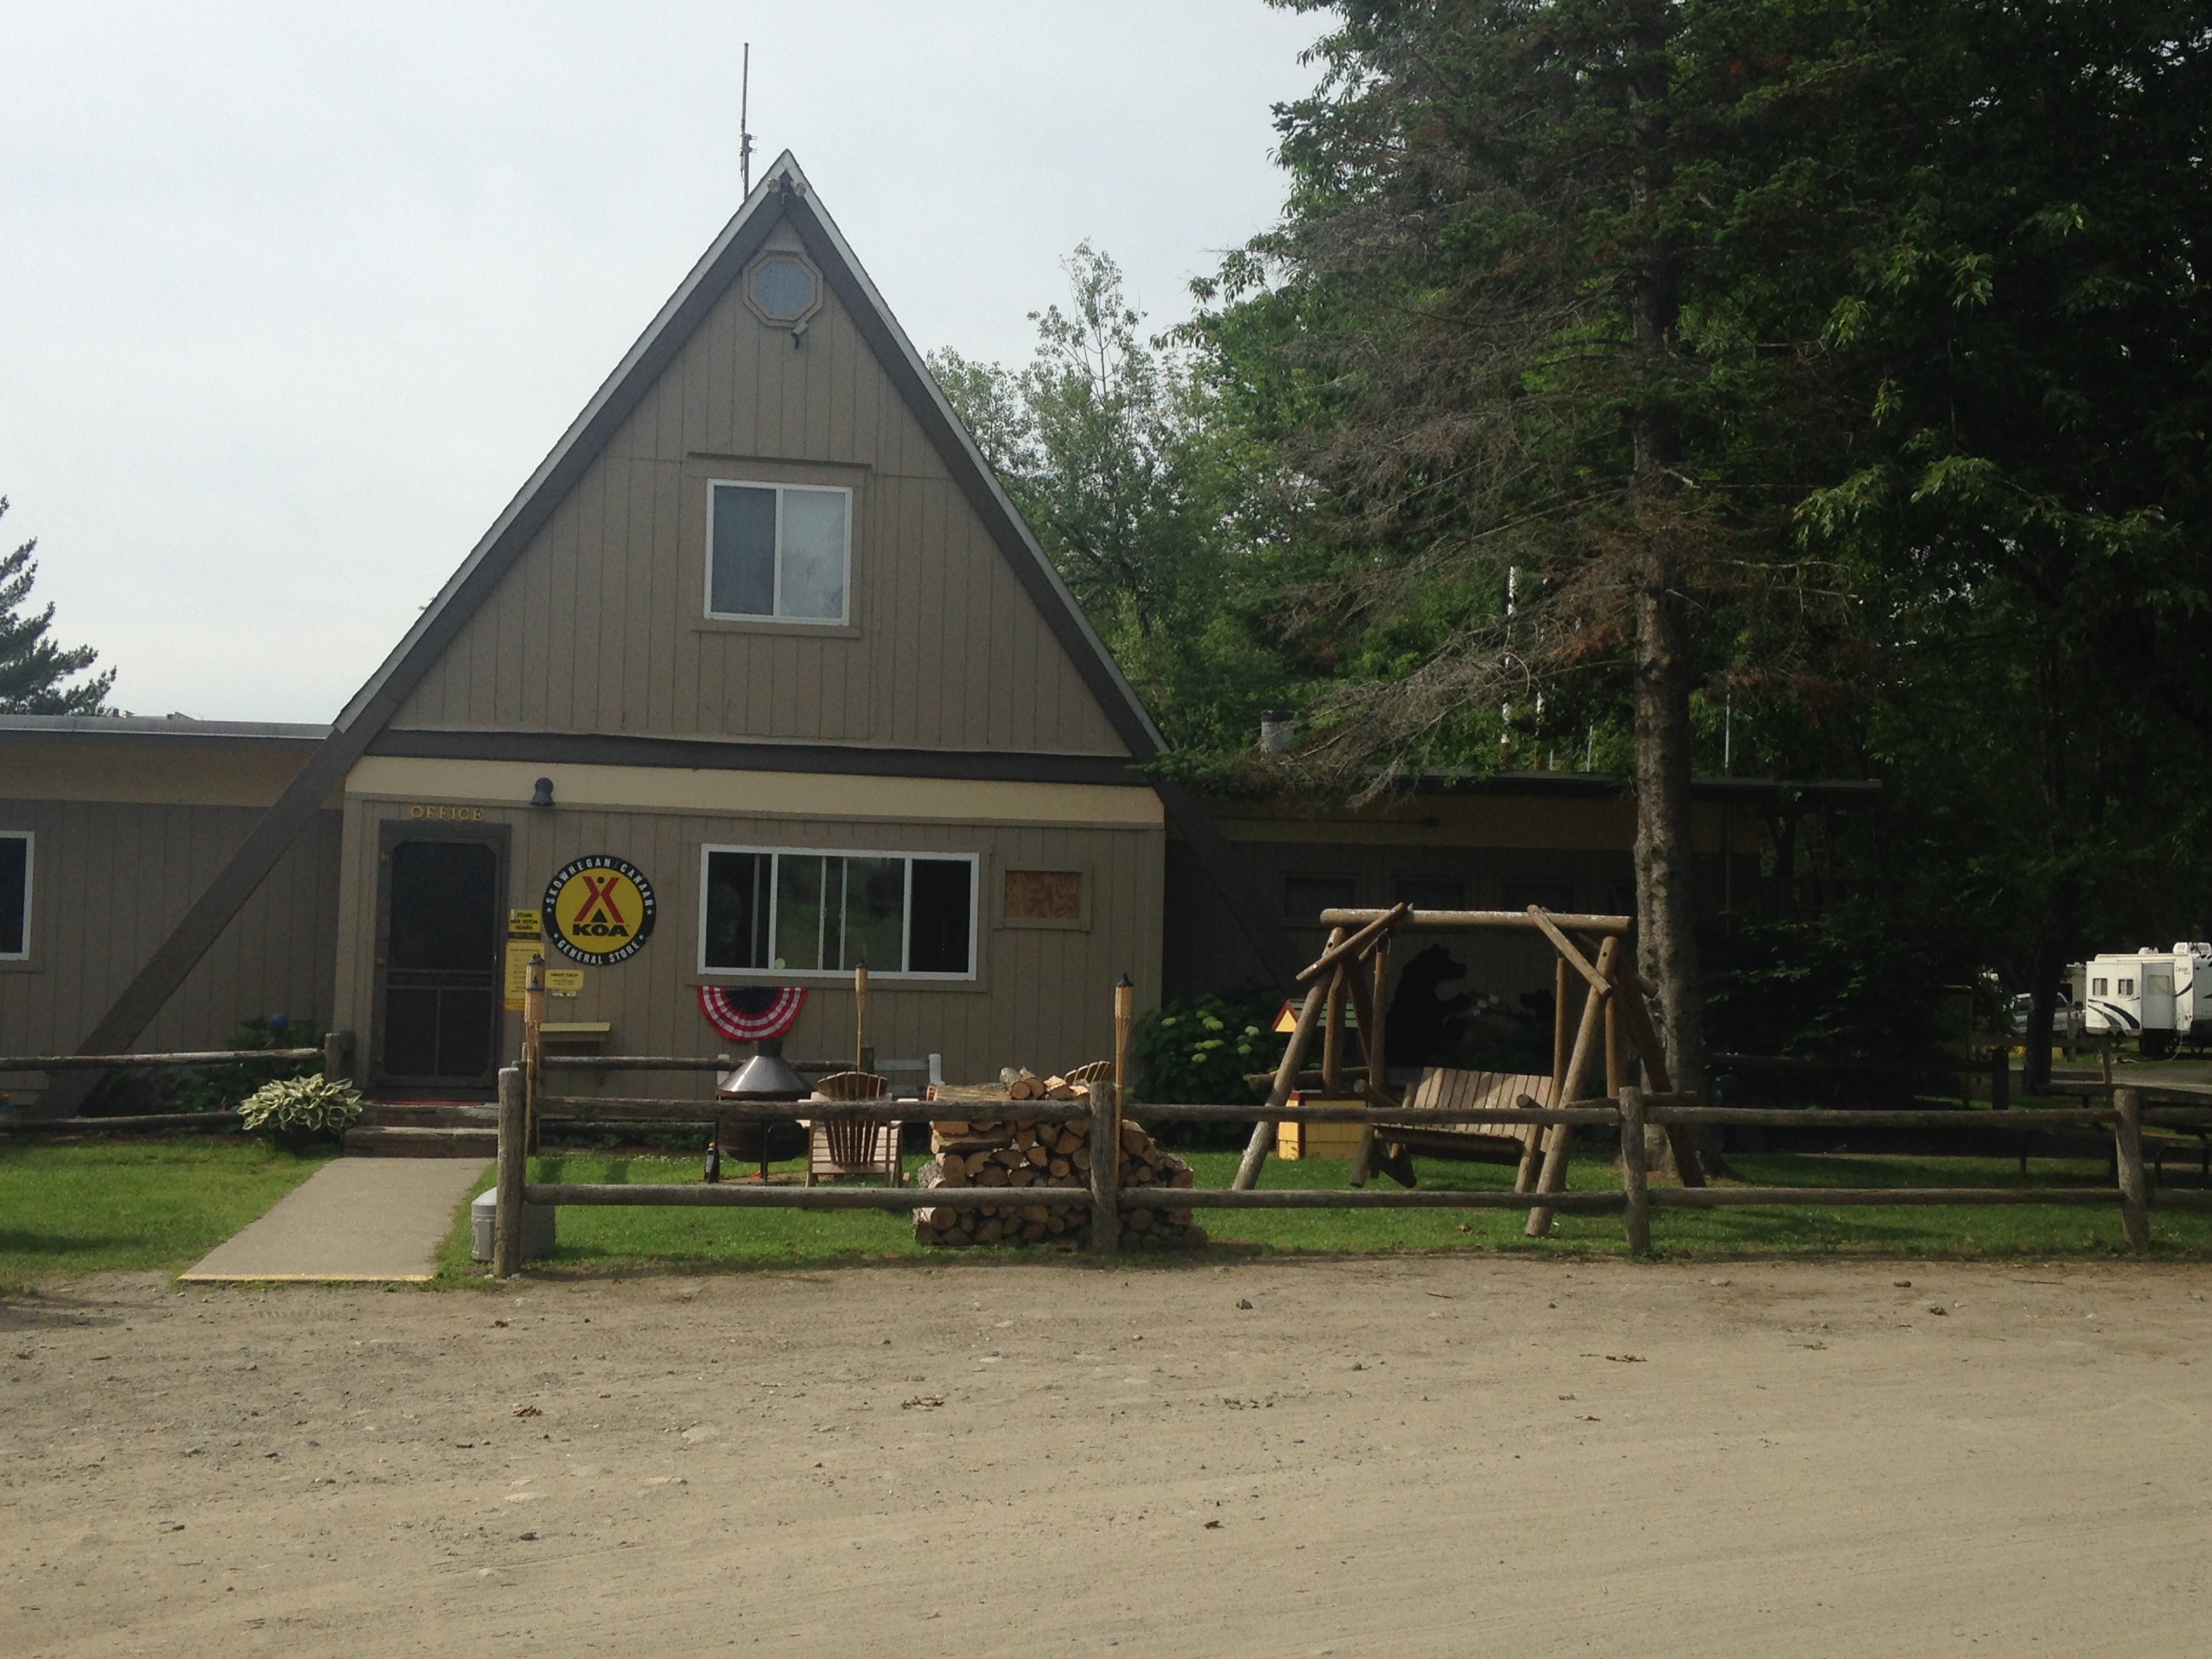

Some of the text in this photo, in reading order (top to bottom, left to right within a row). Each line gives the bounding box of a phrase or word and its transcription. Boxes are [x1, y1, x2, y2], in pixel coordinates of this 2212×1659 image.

[410, 805, 484, 821] OFFICE
[573, 924, 629, 937] KOA
[557, 939, 640, 964] GENERAL STORE
